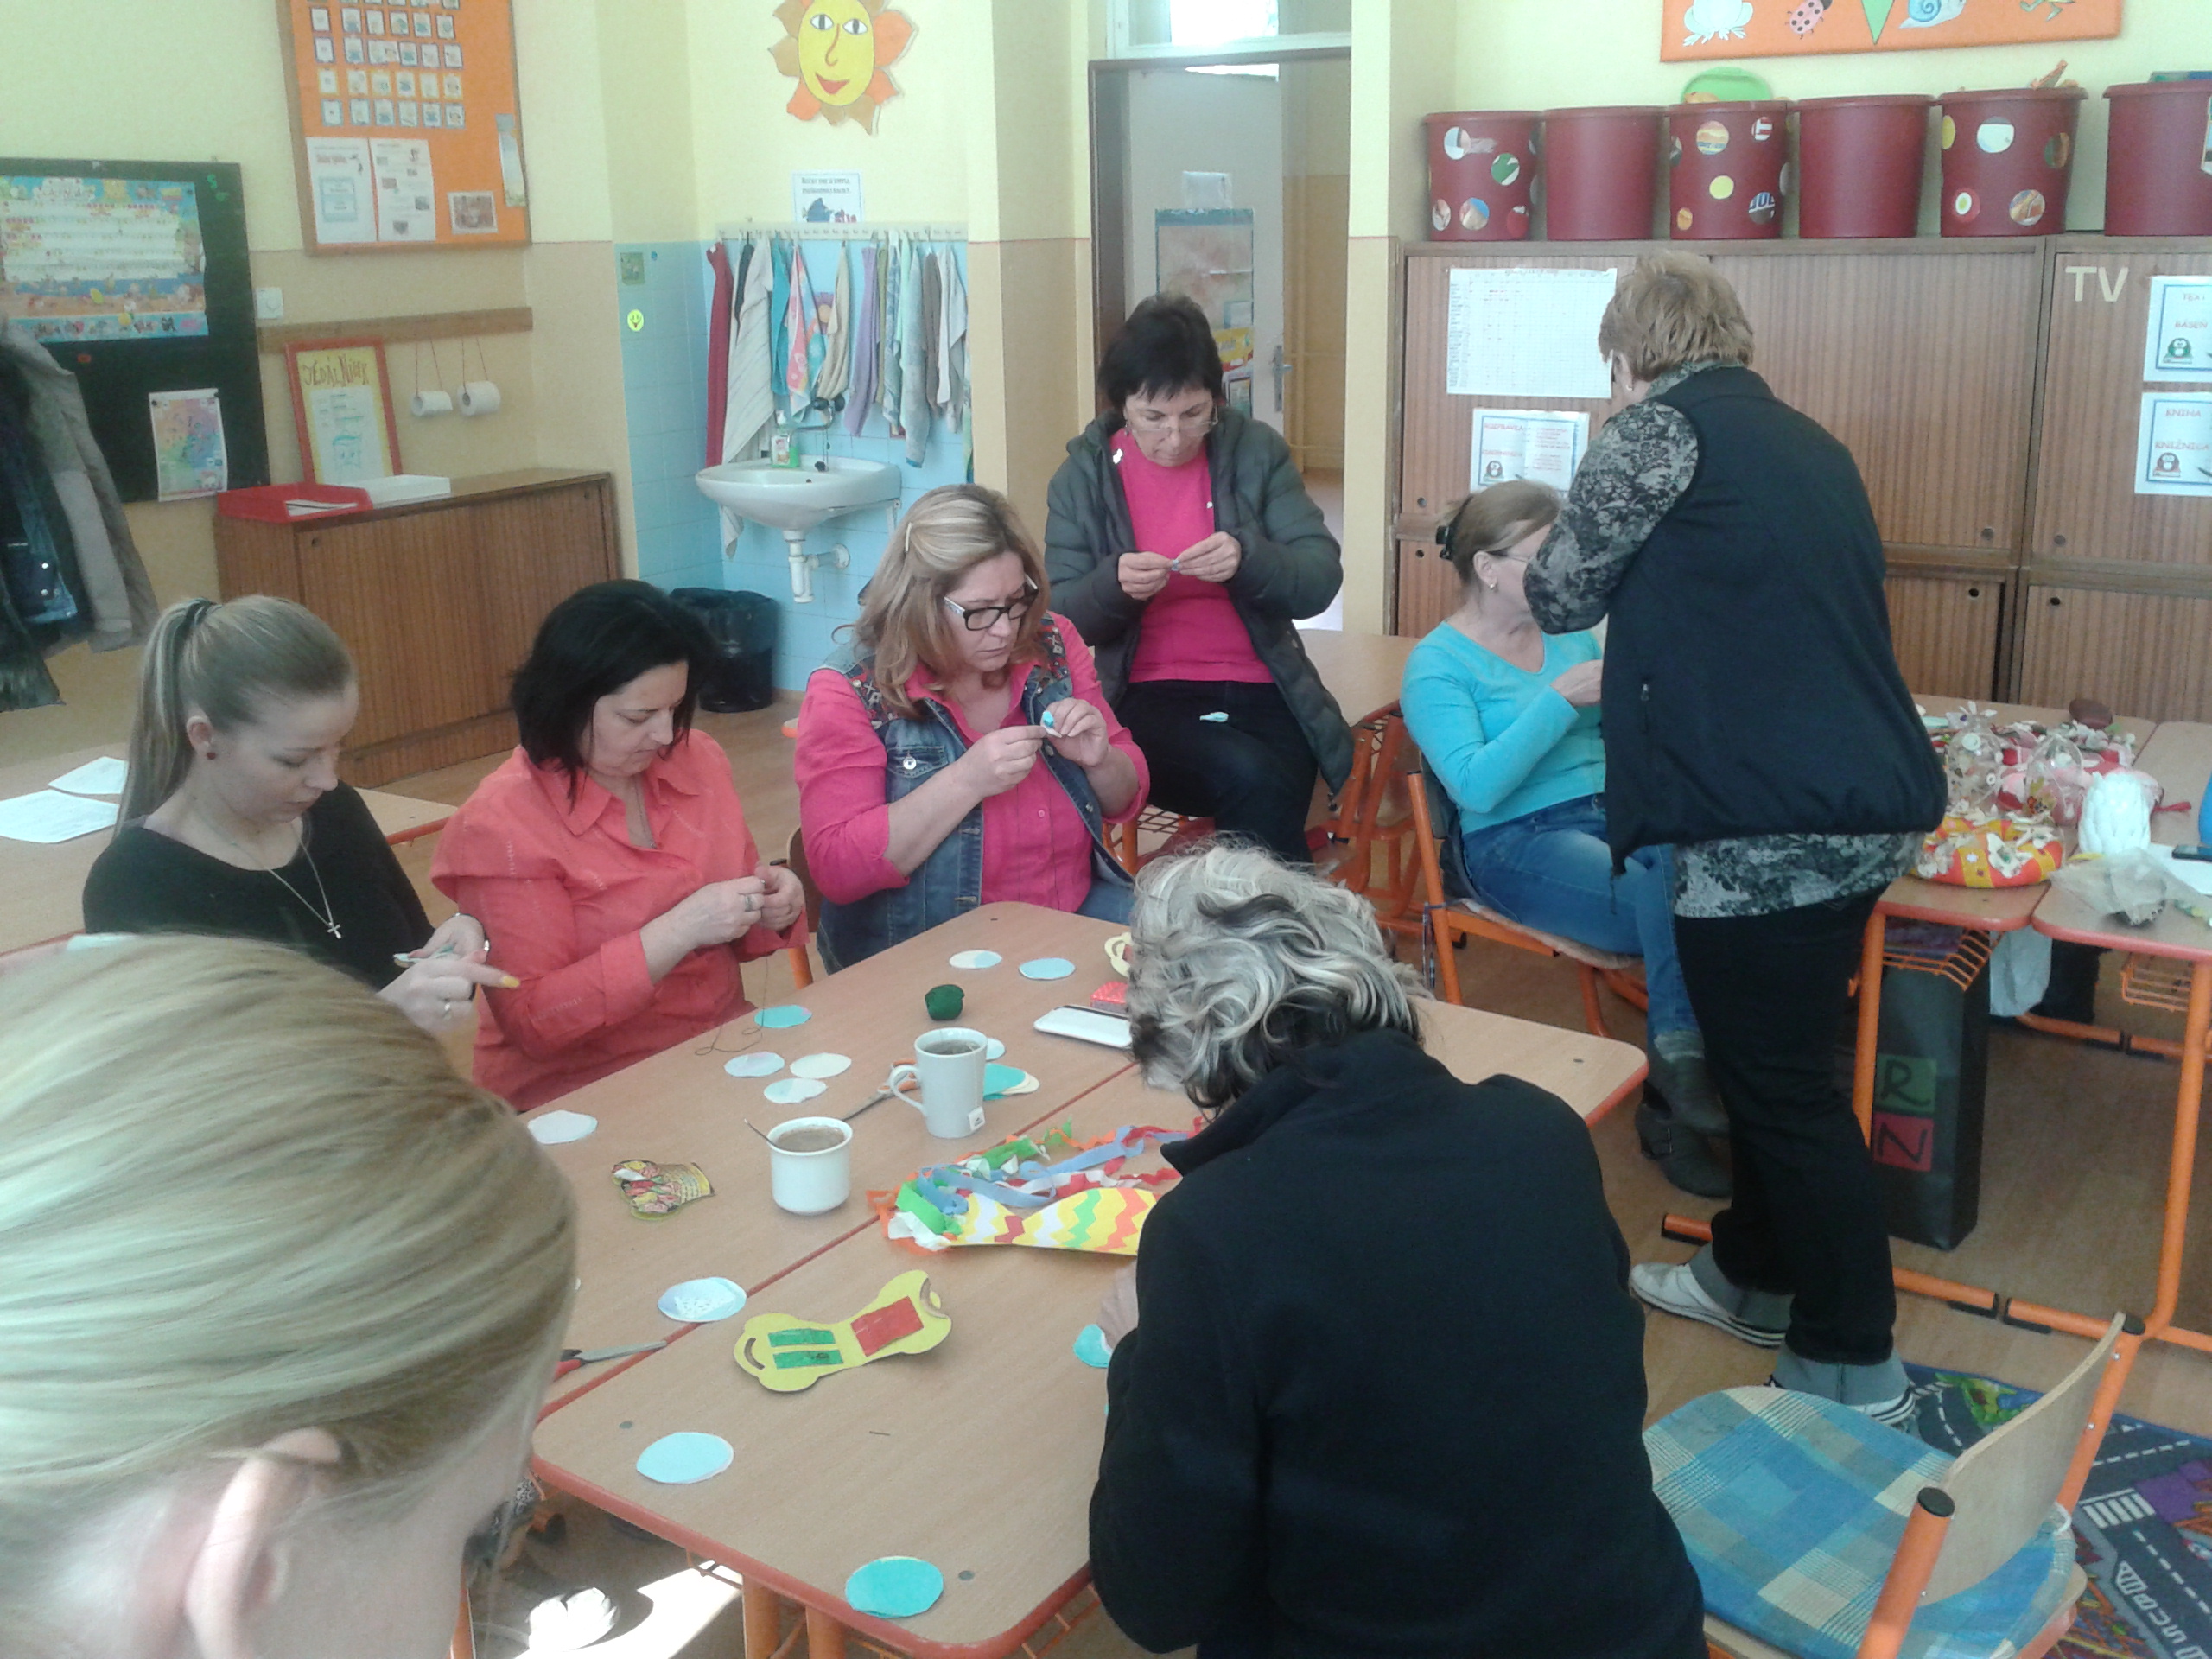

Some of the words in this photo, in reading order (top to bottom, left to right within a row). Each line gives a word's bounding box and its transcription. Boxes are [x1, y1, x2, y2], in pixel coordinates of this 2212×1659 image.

[2065, 266, 2129, 302] TV
[1881, 1059, 1931, 1106] R
[1878, 1122, 1928, 1164] N
[2133, 1593, 2187, 1644] BUS
